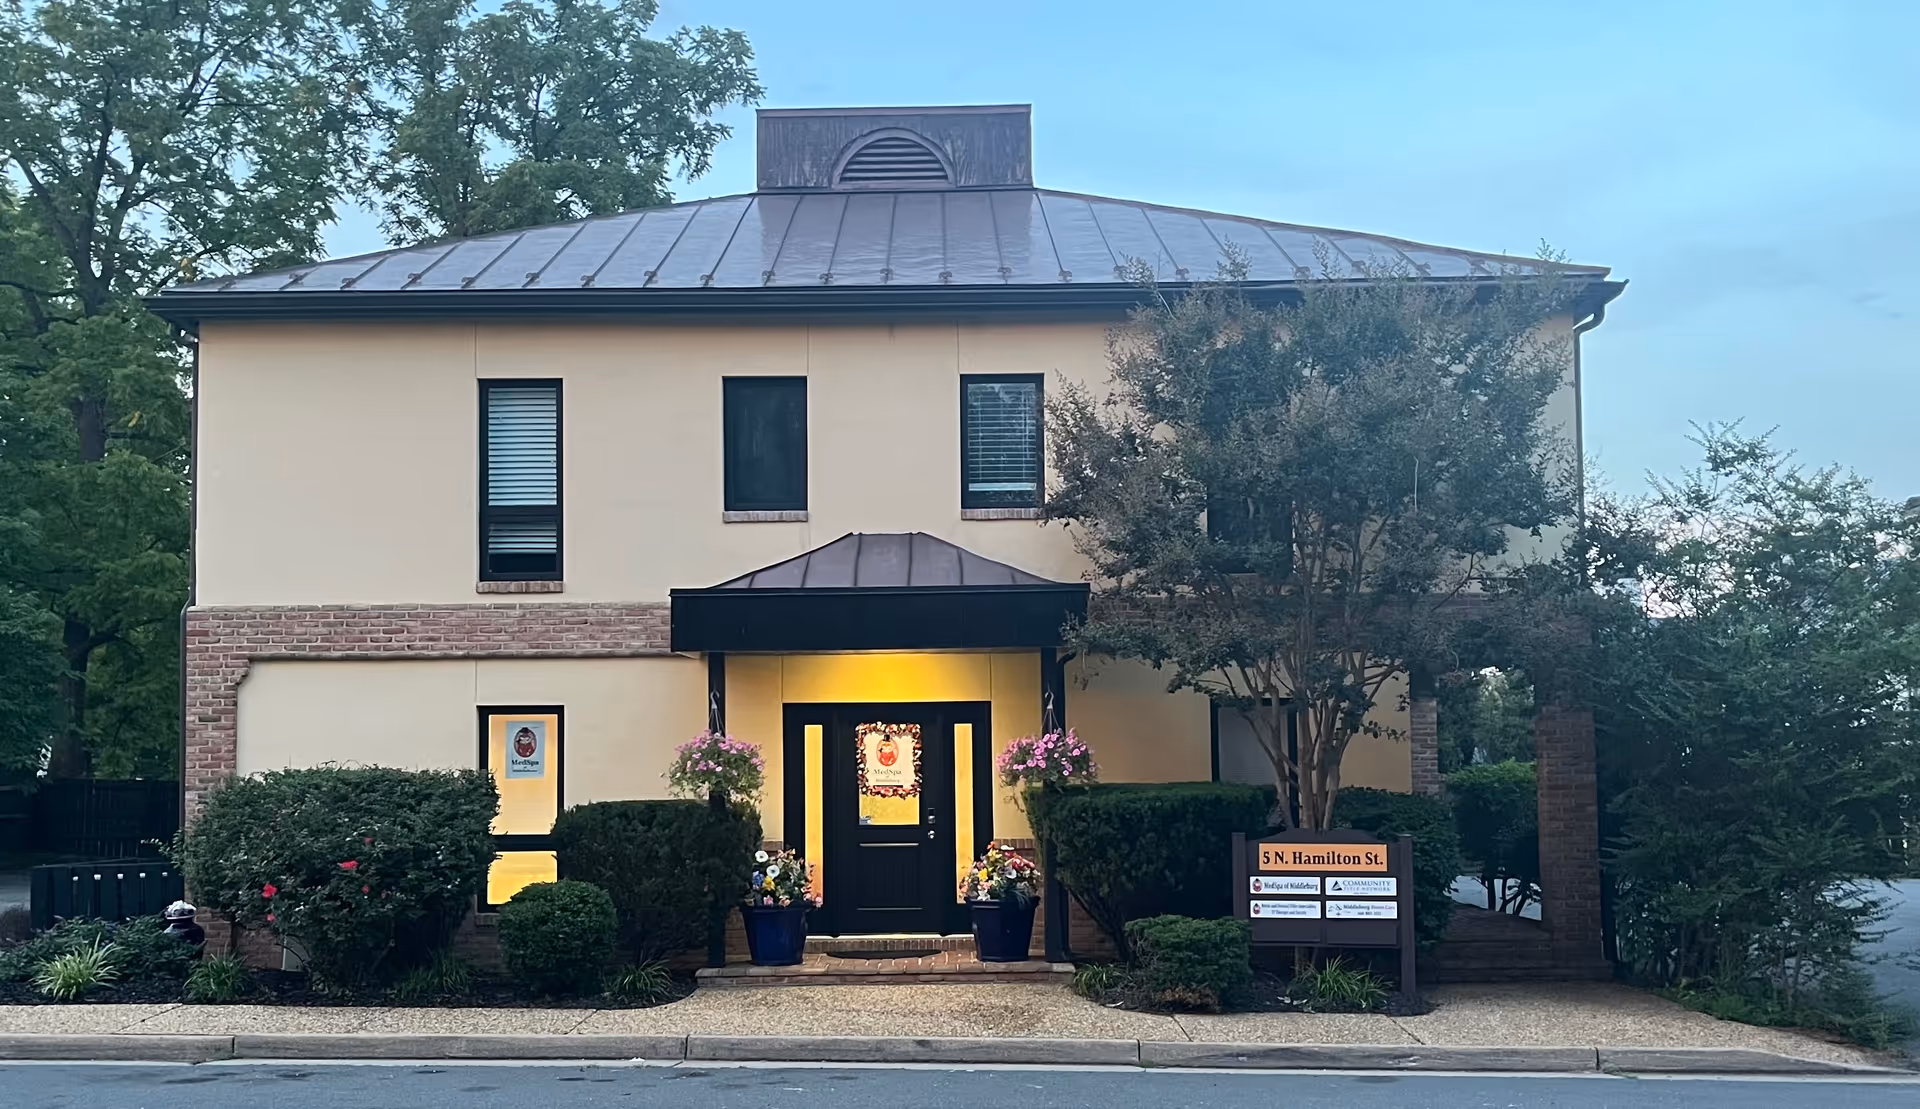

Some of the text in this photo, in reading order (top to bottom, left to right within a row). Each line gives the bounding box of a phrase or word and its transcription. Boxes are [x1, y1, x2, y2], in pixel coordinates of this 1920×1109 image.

[1263, 851, 1384, 866] 5 N. Hamilton St.
[1290, 882, 1318, 891] Middleburg
